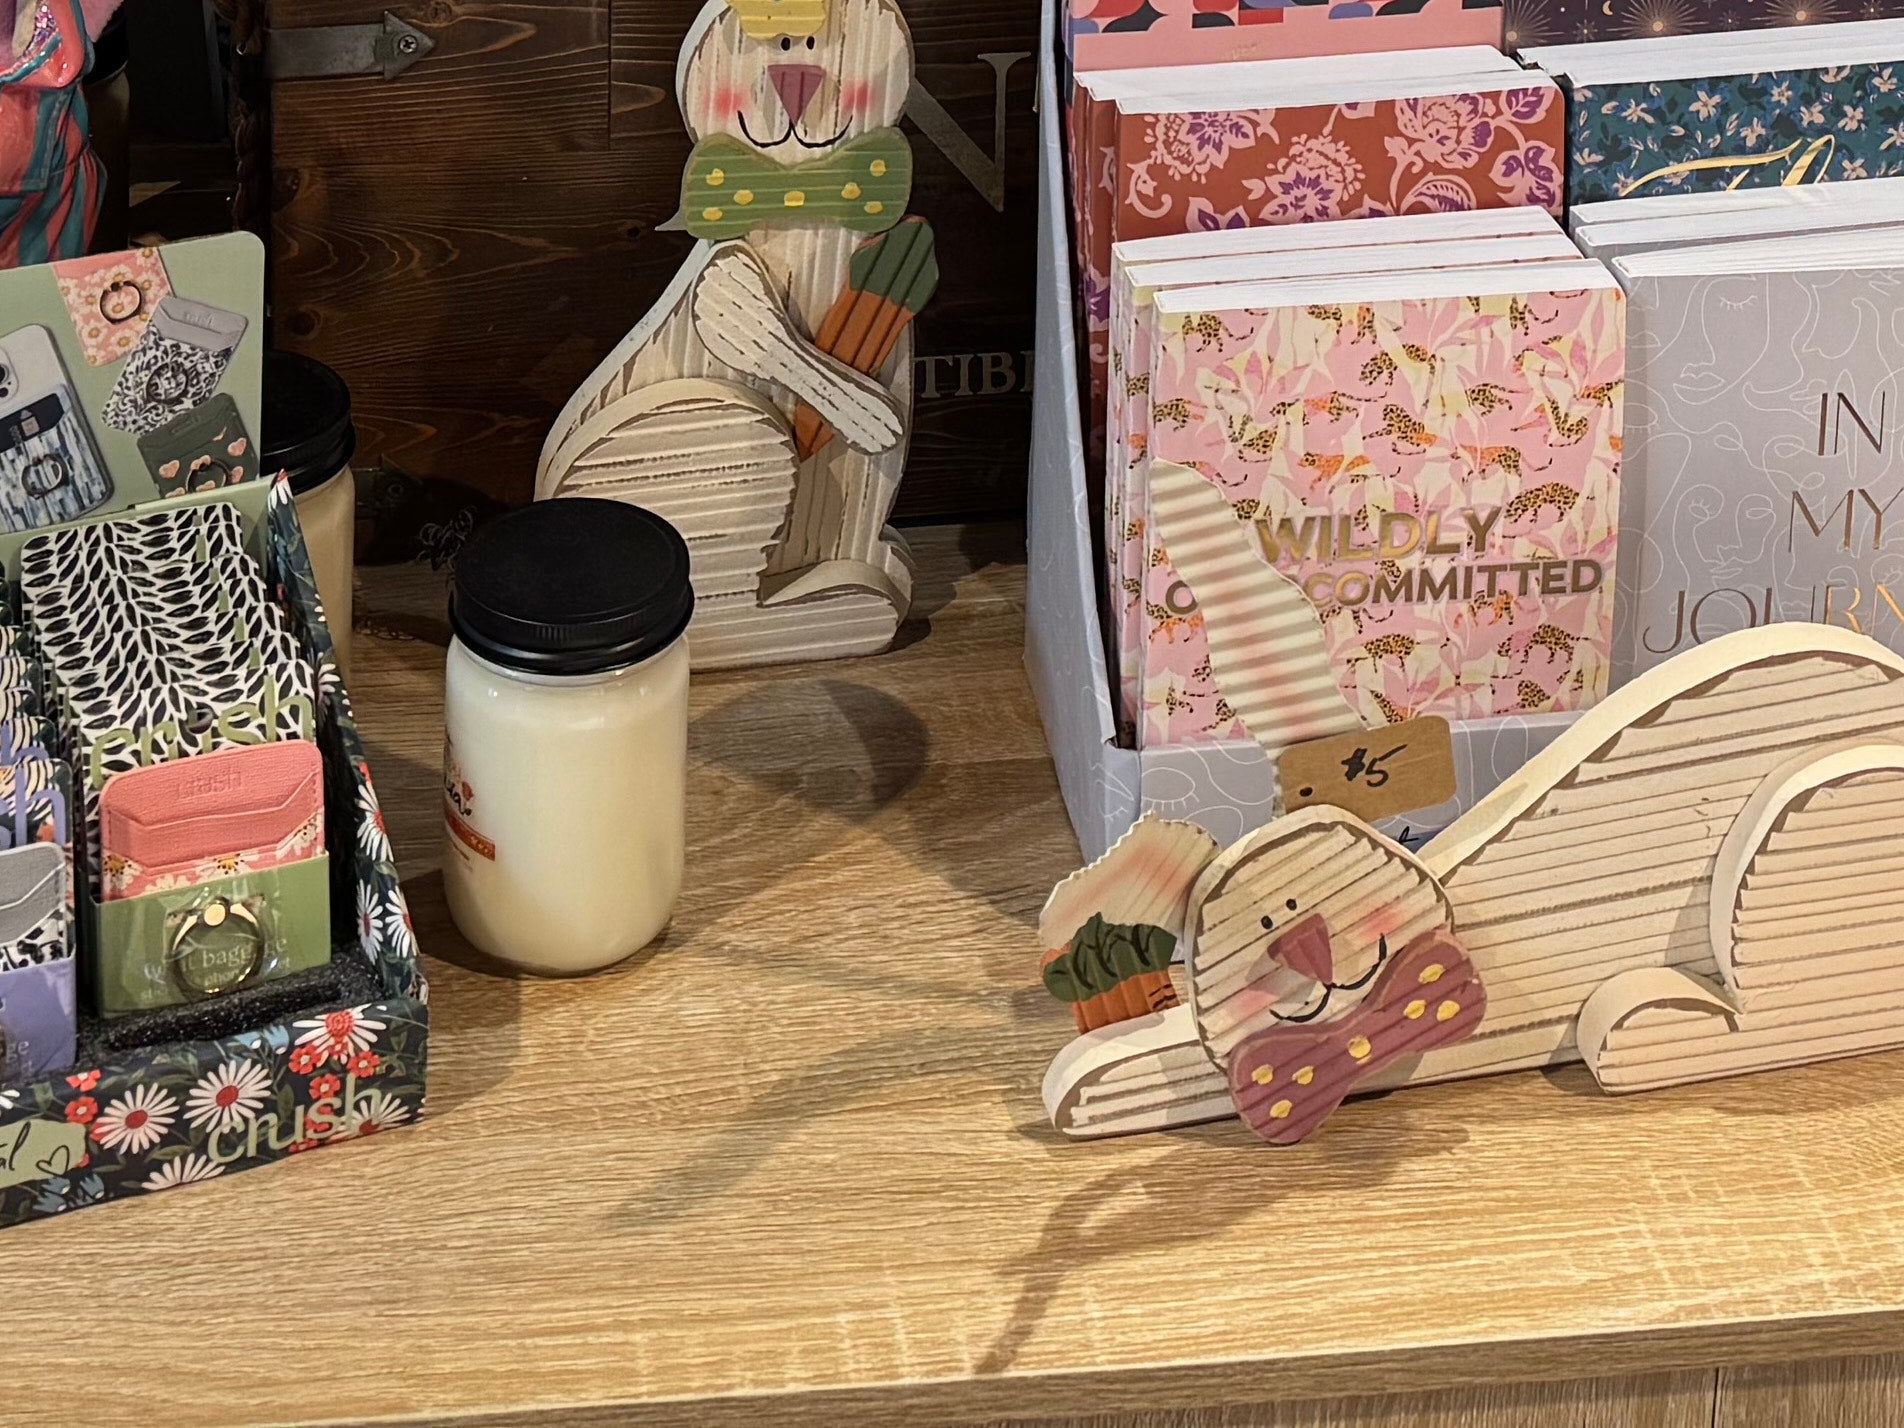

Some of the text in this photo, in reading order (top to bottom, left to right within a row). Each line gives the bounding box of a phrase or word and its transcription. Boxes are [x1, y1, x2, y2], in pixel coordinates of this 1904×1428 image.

[1819, 391, 1886, 458] IN
[1254, 505, 1498, 565] WILDLY
[1790, 486, 1904, 552] MY
[1341, 744, 1408, 787] $5
[208, 1073, 382, 1166] crush
